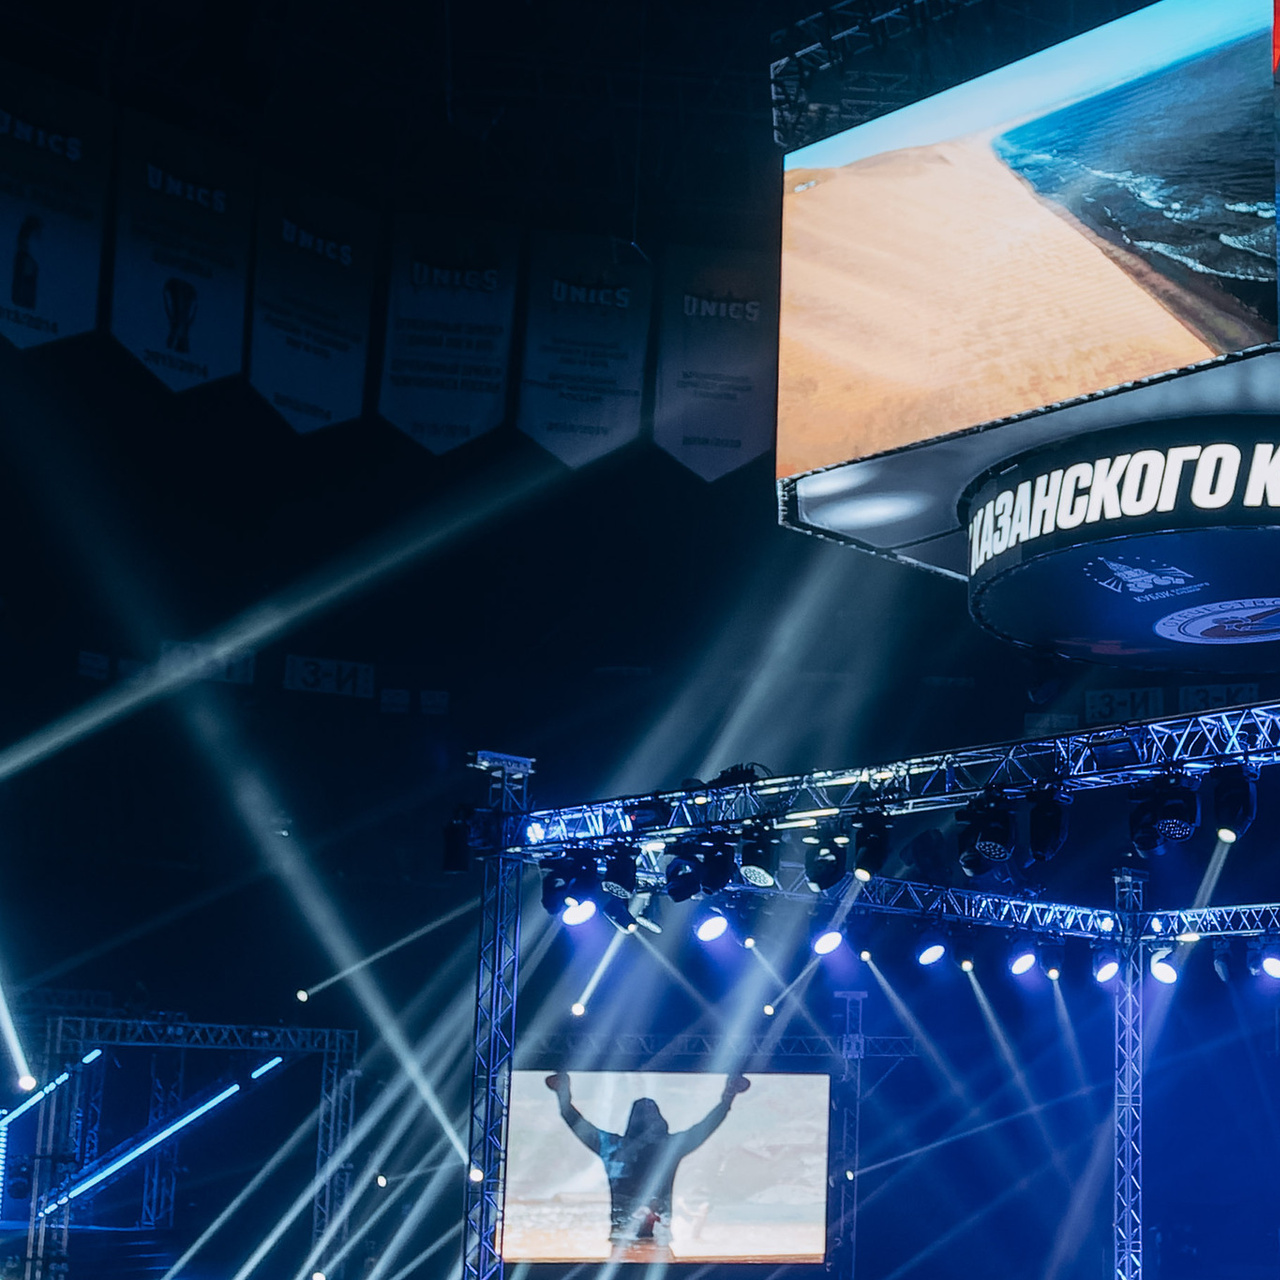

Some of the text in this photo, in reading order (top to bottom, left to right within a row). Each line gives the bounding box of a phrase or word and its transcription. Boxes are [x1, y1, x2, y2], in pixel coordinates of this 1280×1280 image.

[146, 162, 228, 215] UNICS
[281, 218, 353, 267] UNICS
[411, 260, 499, 291] UNICS
[552, 279, 632, 309] UNICS
[683, 294, 761, 322] UNICS
[970, 444, 1242, 577] КАЗАНСКОГО
